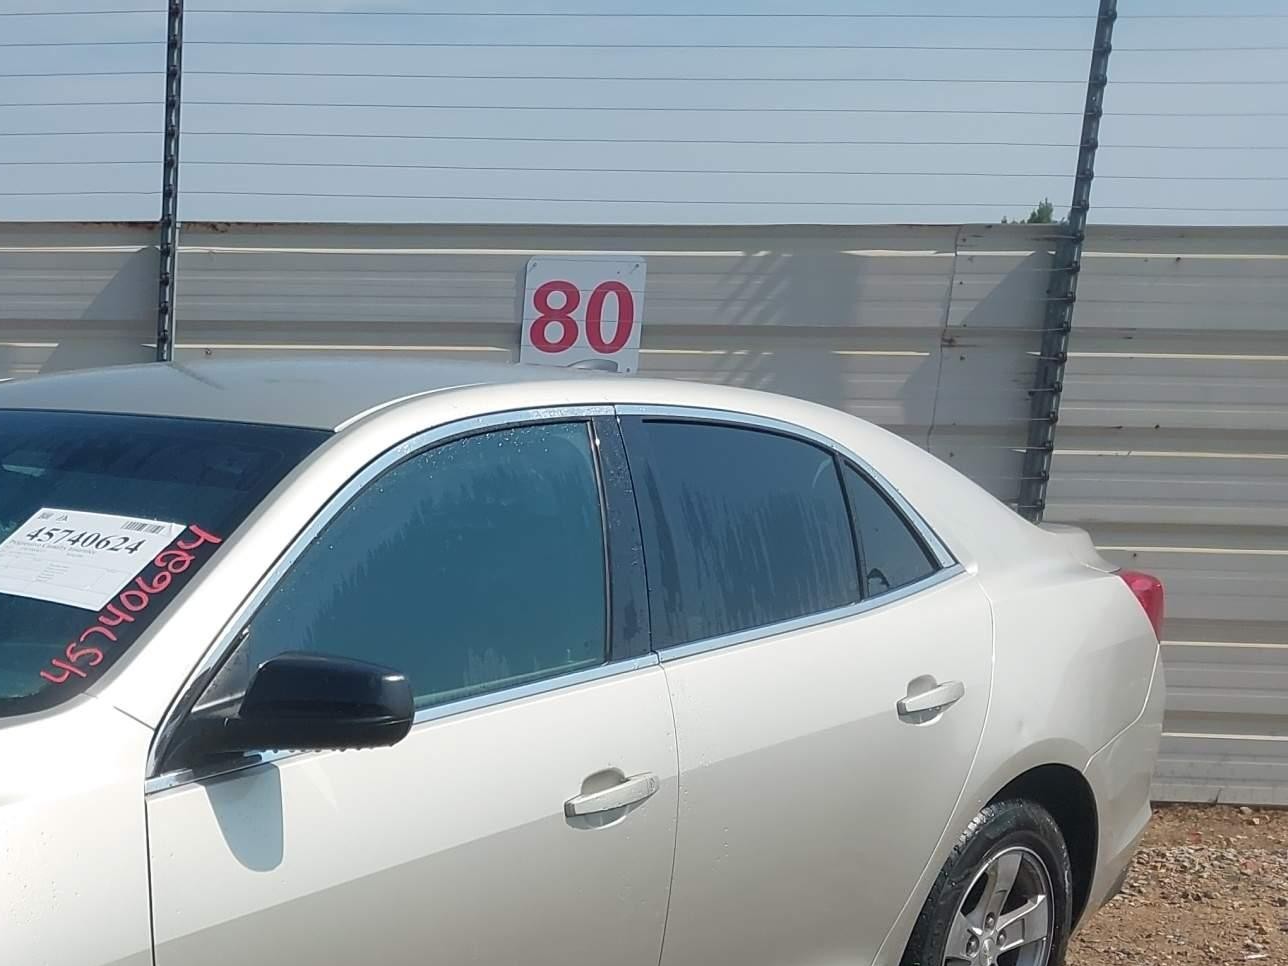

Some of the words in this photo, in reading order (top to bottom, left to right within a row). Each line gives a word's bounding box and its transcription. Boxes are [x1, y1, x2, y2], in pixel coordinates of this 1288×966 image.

[529, 280, 634, 354] 80
[26, 526, 147, 555] 45740624
[40, 523, 223, 683] 45740624
